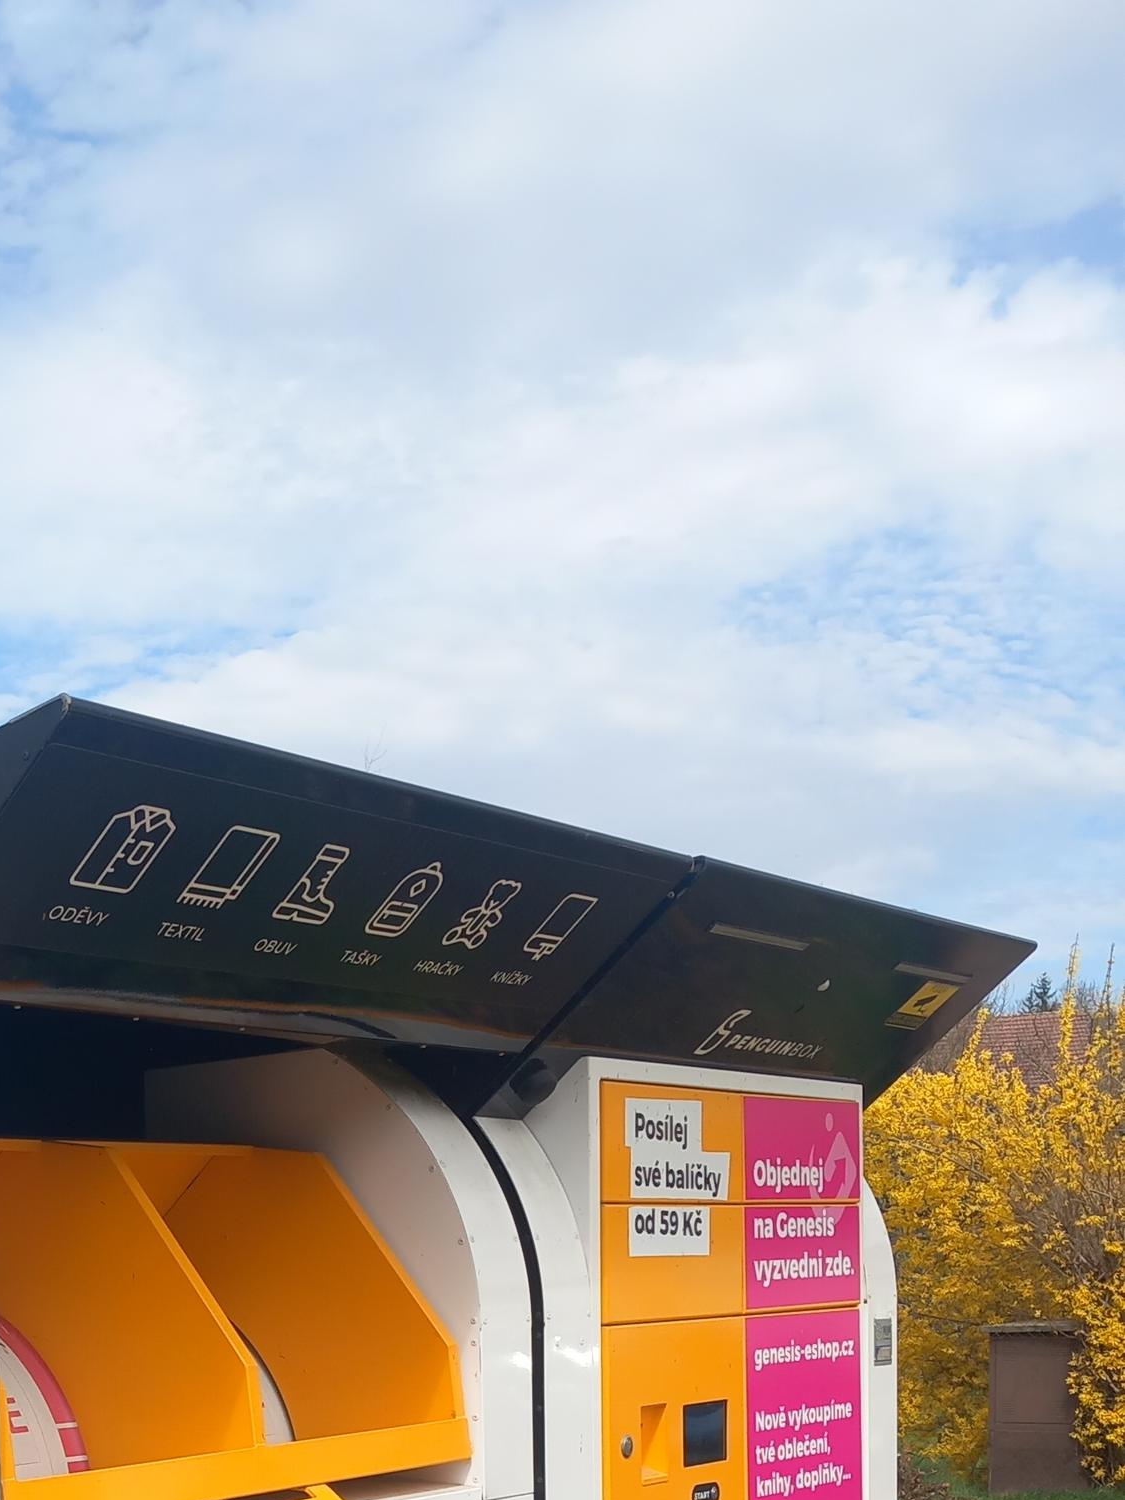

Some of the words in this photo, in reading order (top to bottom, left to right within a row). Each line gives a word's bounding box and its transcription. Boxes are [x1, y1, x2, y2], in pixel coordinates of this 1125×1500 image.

[48, 906, 109, 927] ODĚVY
[157, 922, 205, 942] TEXTIL
[253, 938, 298, 956] OBUV
[339, 950, 383, 967] TAŠKY
[412, 960, 465, 977] HRAČKY
[490, 970, 534, 986] KNÍŽKY
[634, 1112, 688, 1150] Posílej
[634, 1160, 662, 1188] své
[665, 1161, 722, 1198] balíčky
[753, 1157, 824, 1194] Objednej
[634, 1208, 656, 1235] od
[659, 1210, 679, 1236] 59
[683, 1210, 703, 1237] Kč
[754, 1217, 774, 1239] na
[776, 1208, 835, 1238] Genesis
[754, 1249, 822, 1288] vyzvedni
[825, 1249, 855, 1277] zde.
[754, 1337, 855, 1372] genesis-eshop.cz
[755, 1405, 787, 1432] Nově
[788, 1399, 853, 1432] vykoupíme
[755, 1440, 776, 1465] tvé
[777, 1431, 831, 1462] oblečení,
[756, 1471, 795, 1498] knihy,
[795, 1462, 852, 1492] doplňky...
